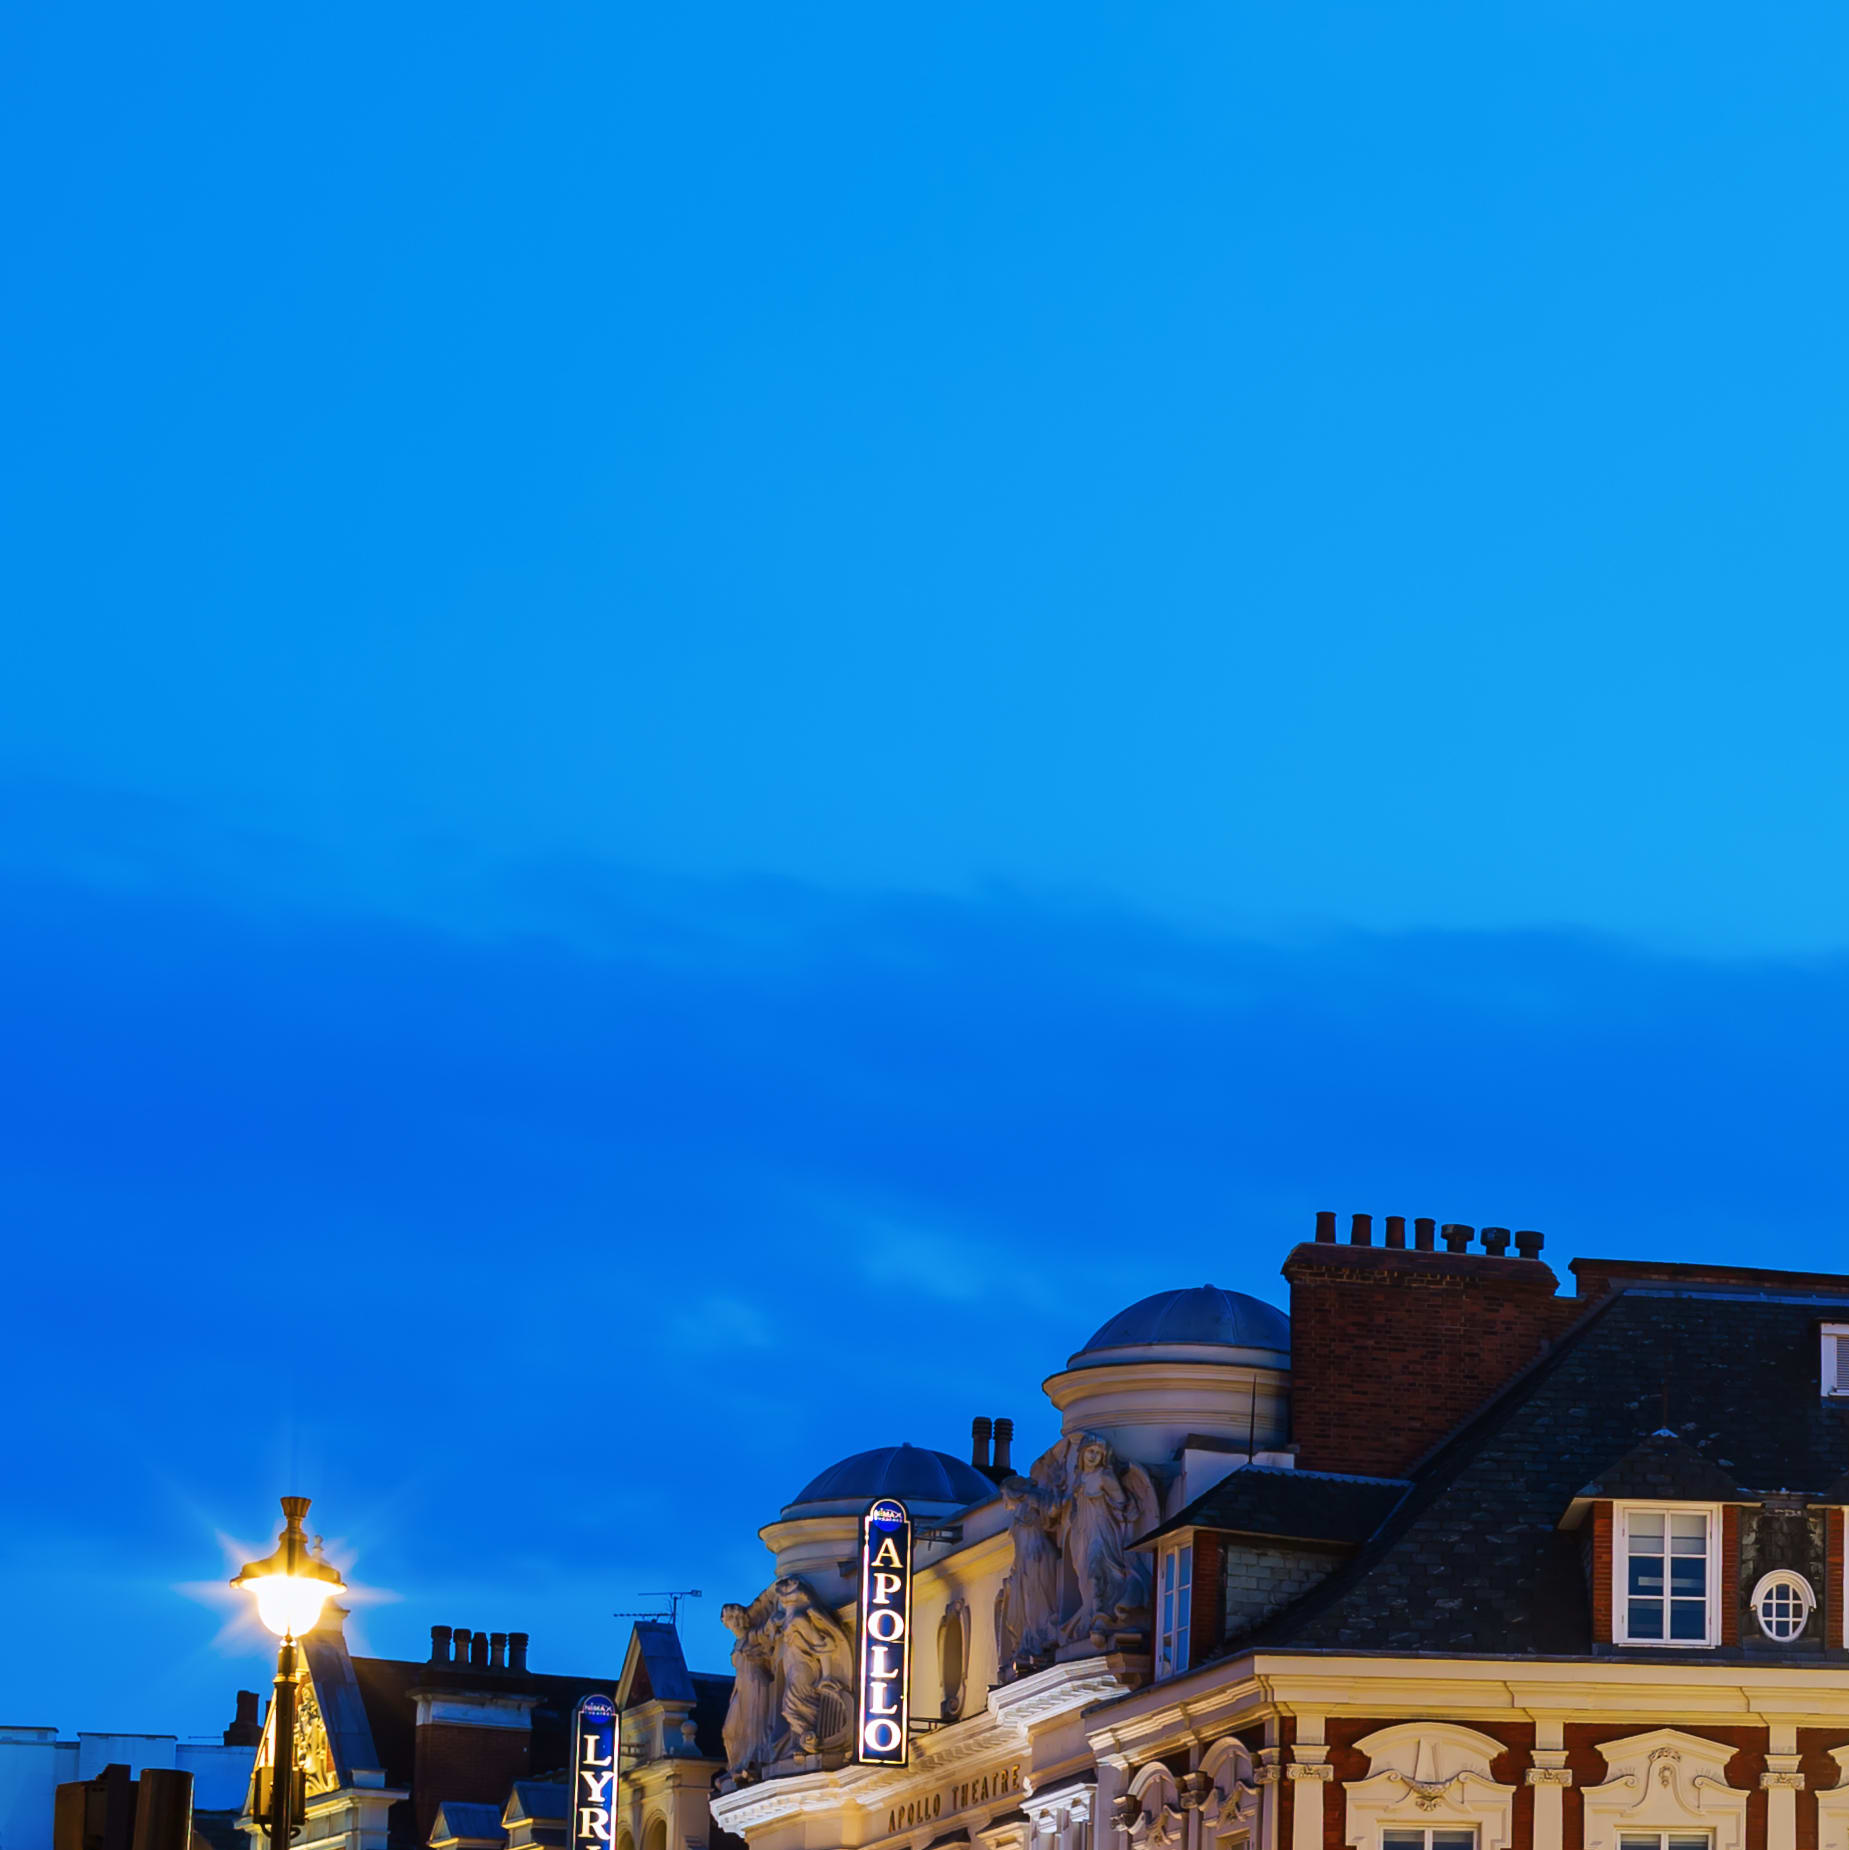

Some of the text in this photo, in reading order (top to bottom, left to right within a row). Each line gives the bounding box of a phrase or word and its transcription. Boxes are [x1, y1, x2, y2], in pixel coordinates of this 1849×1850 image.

[864, 1537, 904, 1752] APOLLO
[888, 1764, 1021, 1834] APOLLO THEATRE
